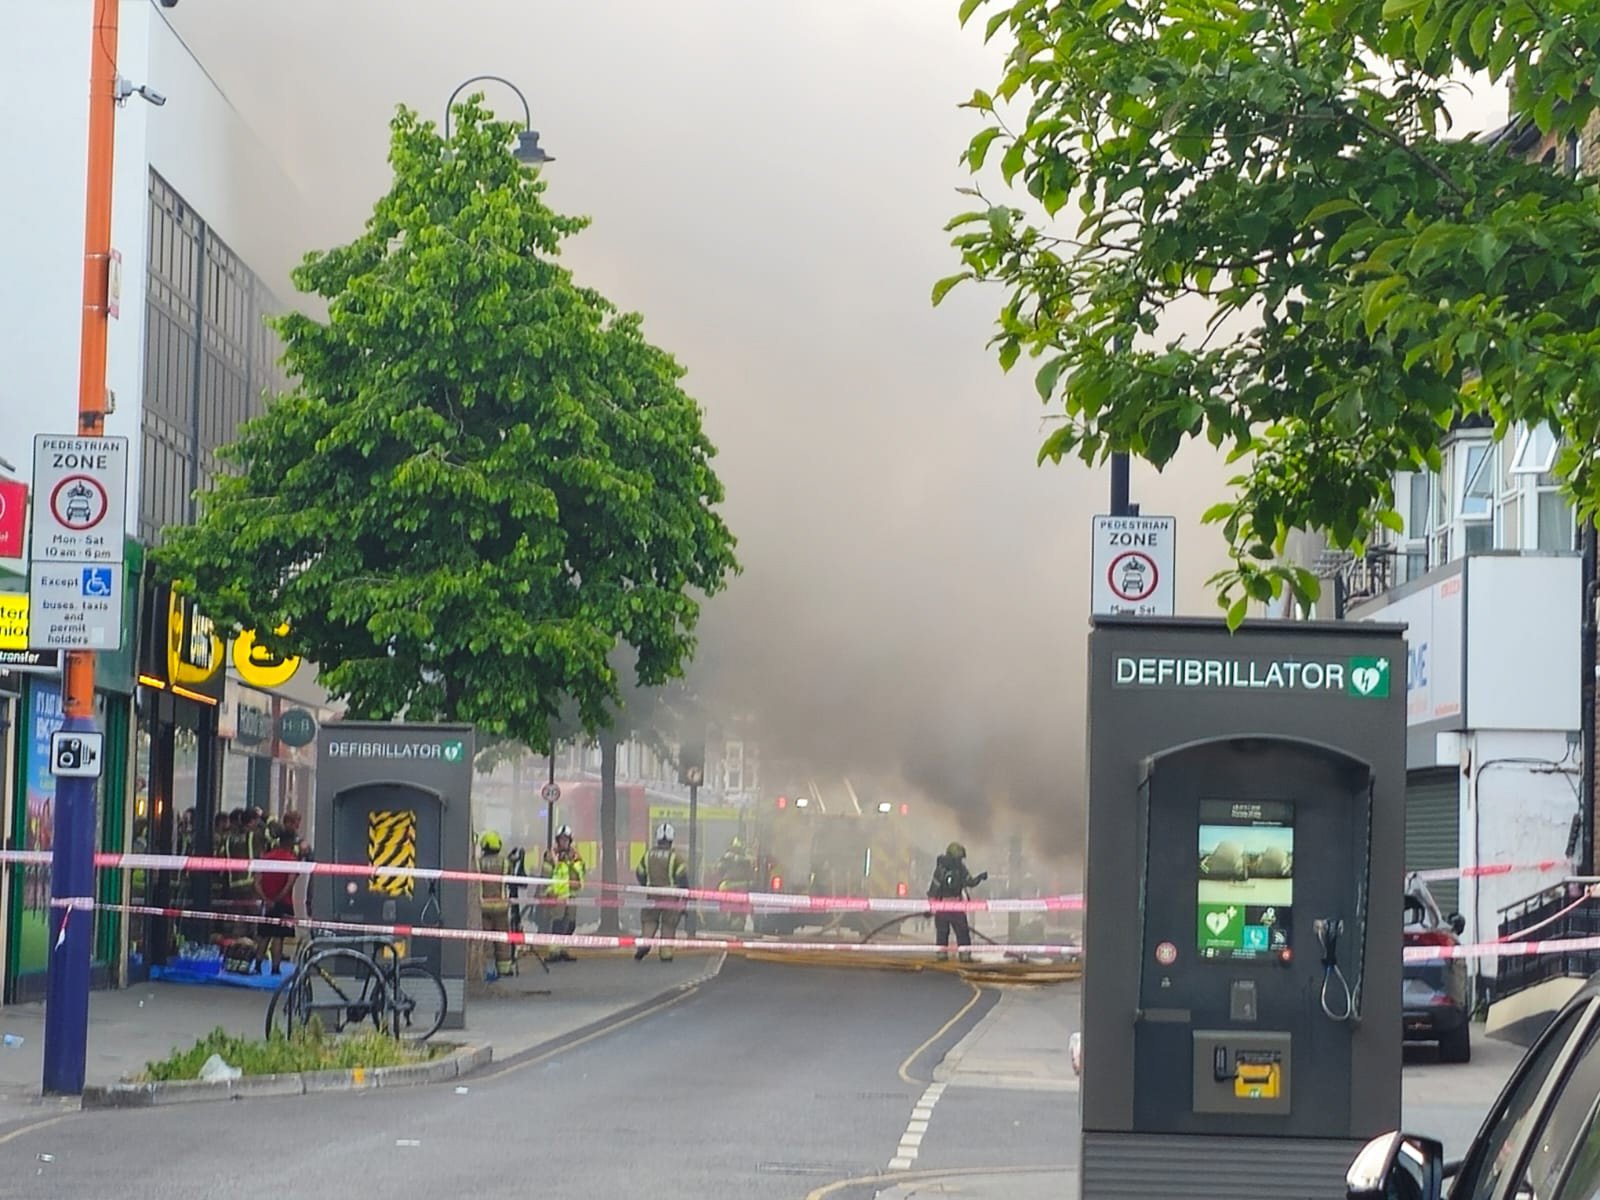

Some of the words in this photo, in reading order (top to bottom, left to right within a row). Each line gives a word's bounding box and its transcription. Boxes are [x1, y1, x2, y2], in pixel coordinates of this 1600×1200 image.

[43, 440, 119, 451] PEDESTRIAN
[53, 454, 107, 469] ZONE
[1100, 520, 1168, 530] PEDESTRIAN
[1109, 532, 1157, 546] ZONE
[41, 576, 78, 588] Except
[83, 600, 108, 610] taxis
[64, 613, 84, 621] and
[50, 623, 86, 634] permit
[48, 634, 88, 645] holders
[1116, 658, 1344, 690] DEFIBRILLATOR
[328, 741, 441, 759] DEFIBRILLATOR
